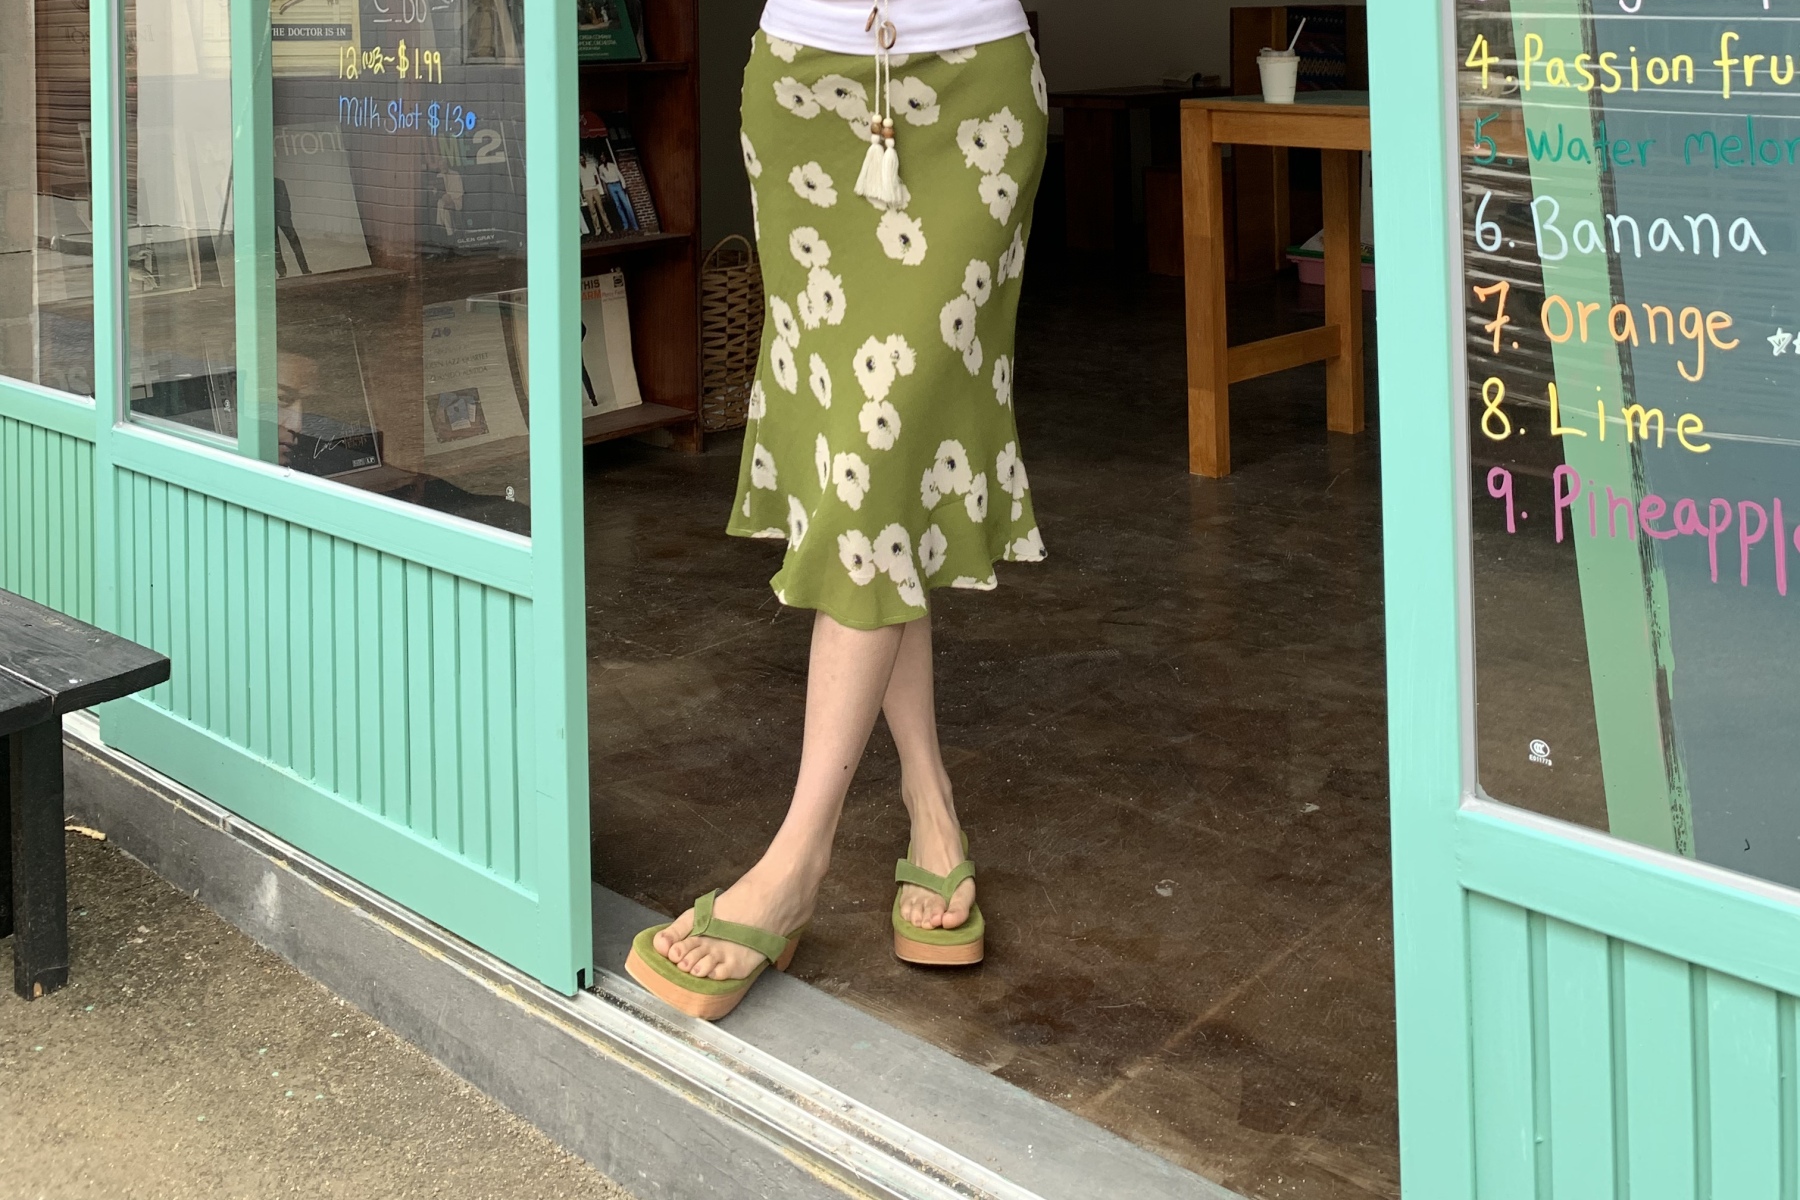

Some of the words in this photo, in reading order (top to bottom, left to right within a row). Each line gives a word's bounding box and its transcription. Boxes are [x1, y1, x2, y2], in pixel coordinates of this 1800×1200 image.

[271, 27, 285, 37] HE
[287, 27, 323, 37] DOCTOR
[324, 27, 334, 37] IS
[336, 27, 347, 37] IN
[1465, 33, 1513, 90] 4.
[1524, 33, 1694, 93] Passion
[1712, 31, 1794, 99] fru
[384, 97, 422, 133] Shot
[472, 129, 506, 165] 2
[1473, 112, 1514, 166] 5.
[1526, 119, 1656, 172] Water
[1475, 191, 1516, 252] 6.
[1530, 195, 1767, 261] Banana
[1473, 280, 1519, 354] 7.
[1540, 294, 1740, 382] Orange
[1480, 375, 1527, 441] 8.
[1547, 380, 1711, 453] Lime
[1486, 466, 1529, 533] 9.
[1552, 464, 1800, 597] Pineappl
